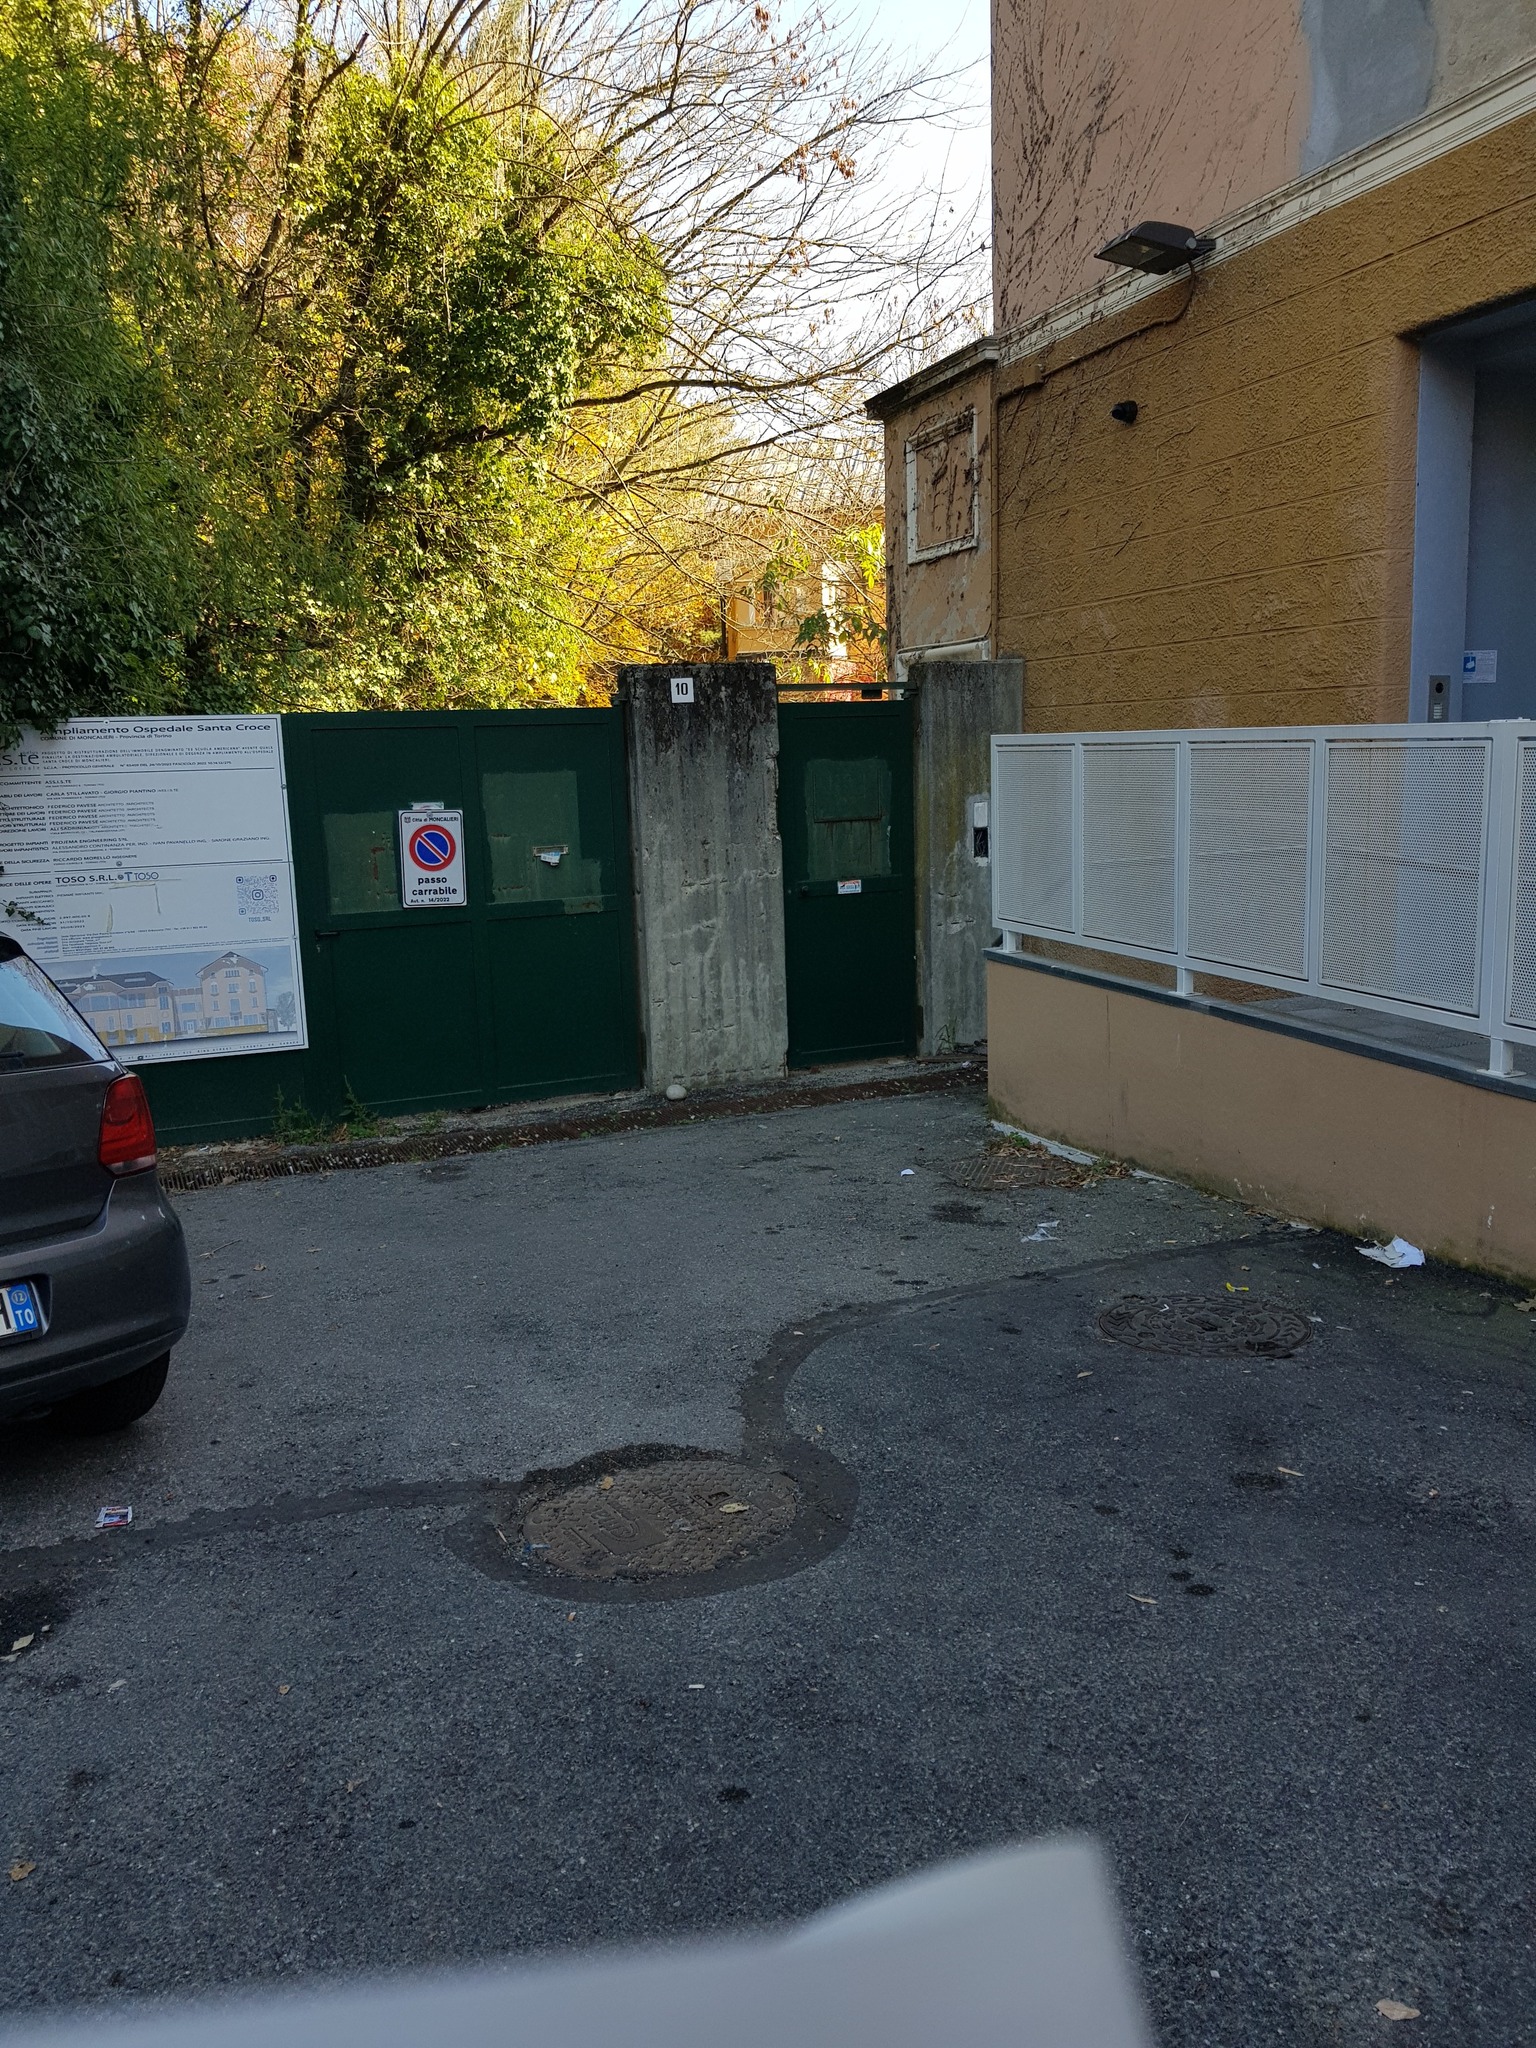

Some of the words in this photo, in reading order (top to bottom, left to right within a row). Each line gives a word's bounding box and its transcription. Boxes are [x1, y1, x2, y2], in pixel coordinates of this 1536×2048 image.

[675, 682, 689, 696] 10
[133, 724, 194, 735] Ospedale
[197, 723, 232, 732] Santa
[236, 723, 271, 731] Croce
[55, 876, 86, 884] TOSO
[89, 874, 117, 882] S.R.L.
[134, 871, 159, 881] TOSO
[417, 876, 447, 885] passo
[412, 886, 457, 896] carrabile
[14, 1293, 24, 1302] 12
[15, 1308, 34, 1326] TO
